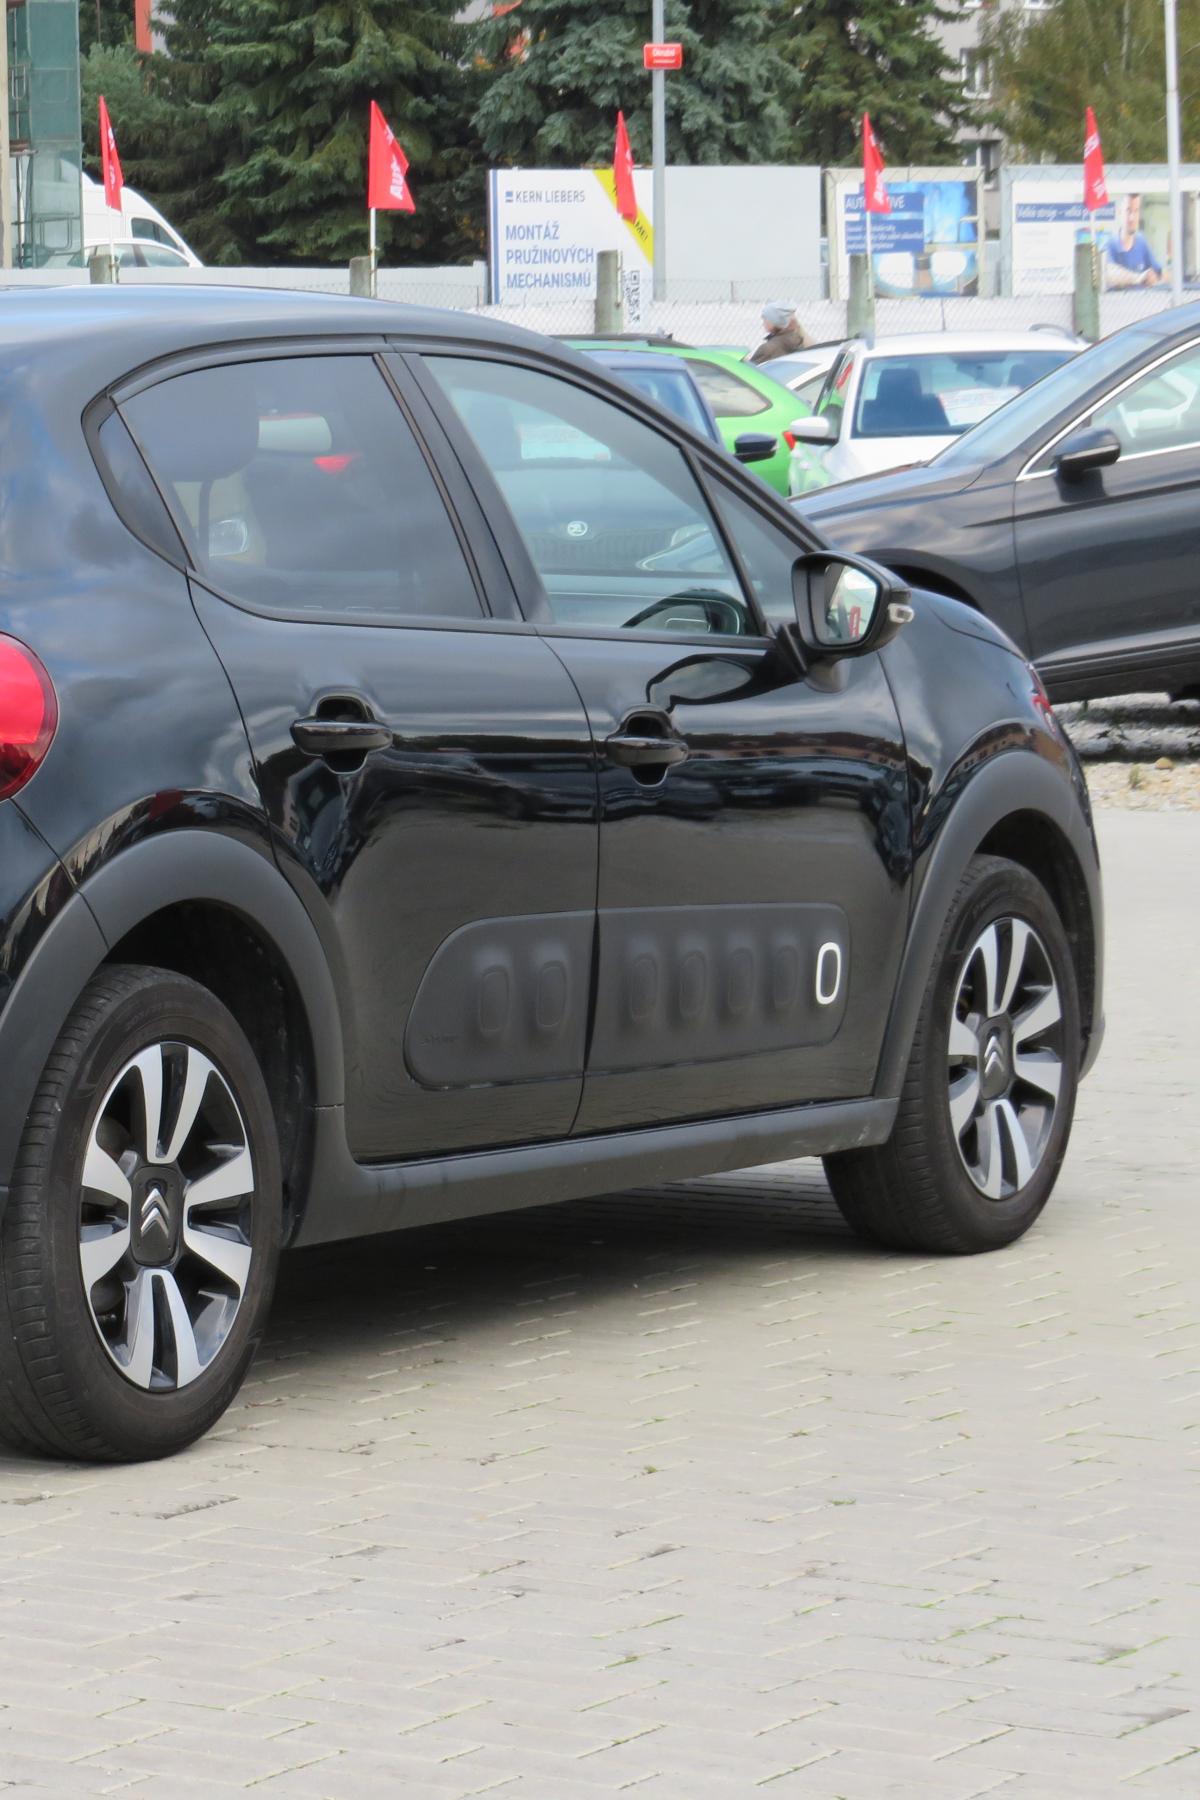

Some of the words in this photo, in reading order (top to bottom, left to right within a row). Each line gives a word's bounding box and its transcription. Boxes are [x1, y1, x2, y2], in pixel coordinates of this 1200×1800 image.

[515, 190, 543, 203] KERN
[545, 189, 586, 203] LIEBERS
[505, 220, 560, 241] MONTÁŽ
[505, 243, 594, 264] PRUŽINOVÝCH
